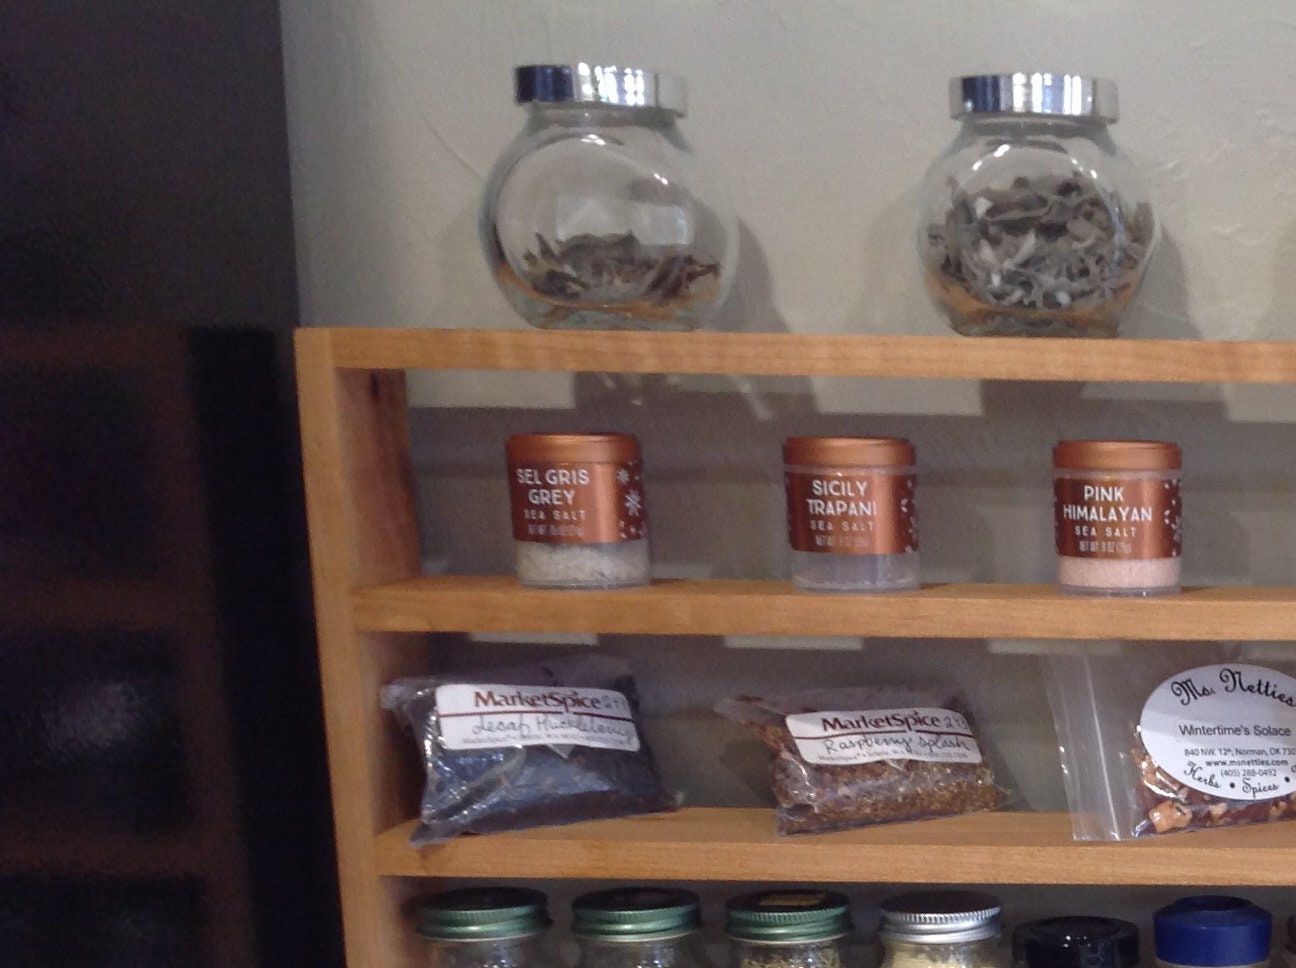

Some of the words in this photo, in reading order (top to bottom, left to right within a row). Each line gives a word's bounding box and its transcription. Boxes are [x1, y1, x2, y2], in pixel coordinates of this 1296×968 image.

[517, 469, 541, 484] SEL
[546, 469, 590, 485] GRIS
[812, 480, 867, 496] SICILY
[1084, 485, 1123, 502] PINK
[529, 490, 576, 505] GREY
[553, 510, 586, 520] SALT
[806, 499, 877, 516] TRAPANI
[1063, 504, 1152, 521] HIMALAYAN
[842, 521, 874, 532] SALT
[1074, 527, 1096, 536] SEA
[1105, 527, 1136, 537] SALT
[1220, 668, 1296, 707] Netties
[474, 690, 601, 713] MarketSpice
[821, 711, 940, 731] MarketSpice
[1179, 725, 1249, 736] Wintertime's
[1253, 725, 1291, 736] Solace
[1183, 761, 1221, 789] Herbs
[1242, 778, 1279, 798] Spices
